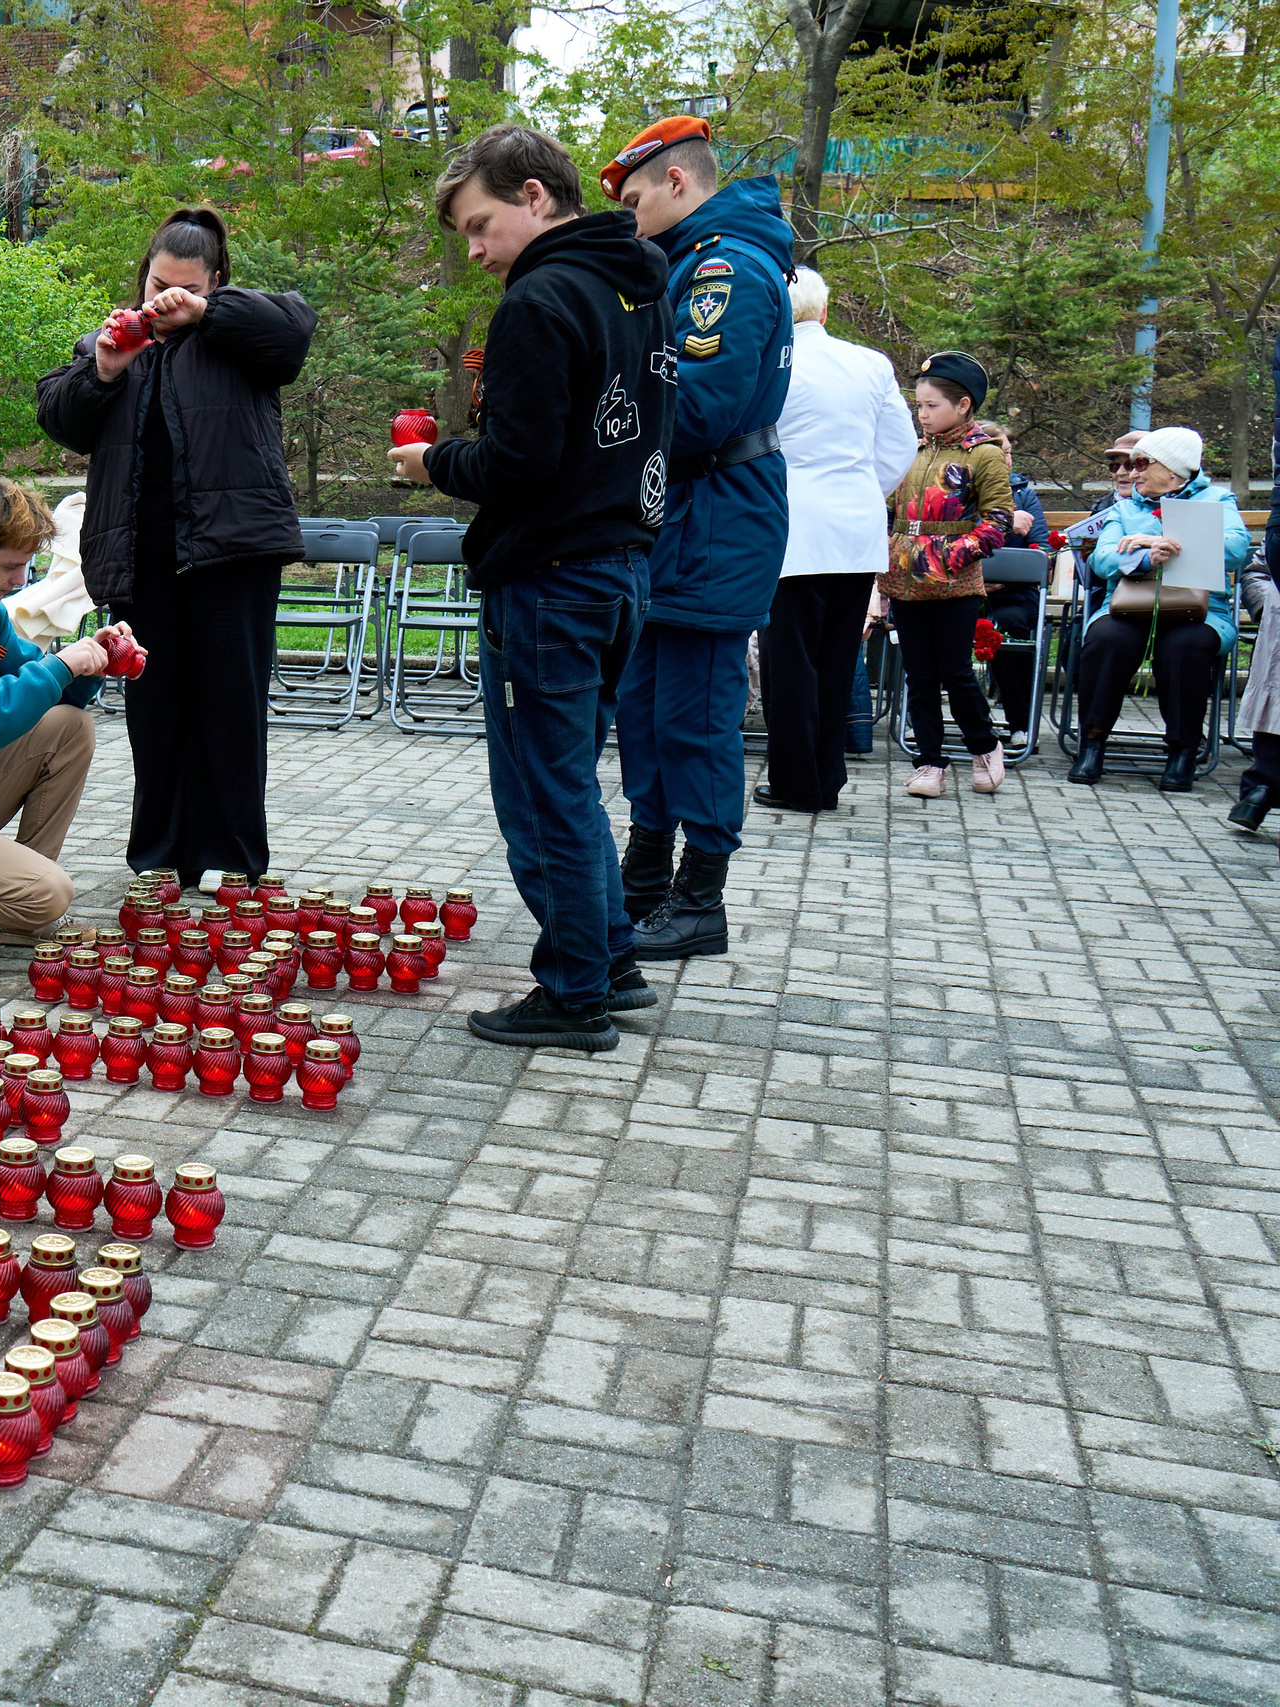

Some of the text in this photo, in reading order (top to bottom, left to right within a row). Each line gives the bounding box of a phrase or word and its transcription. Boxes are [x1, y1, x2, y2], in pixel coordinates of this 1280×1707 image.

[701, 267, 727, 275] РОССИЯ
[707, 283, 729, 291] РОССИИ
[1087, 525, 1094, 535] 9
